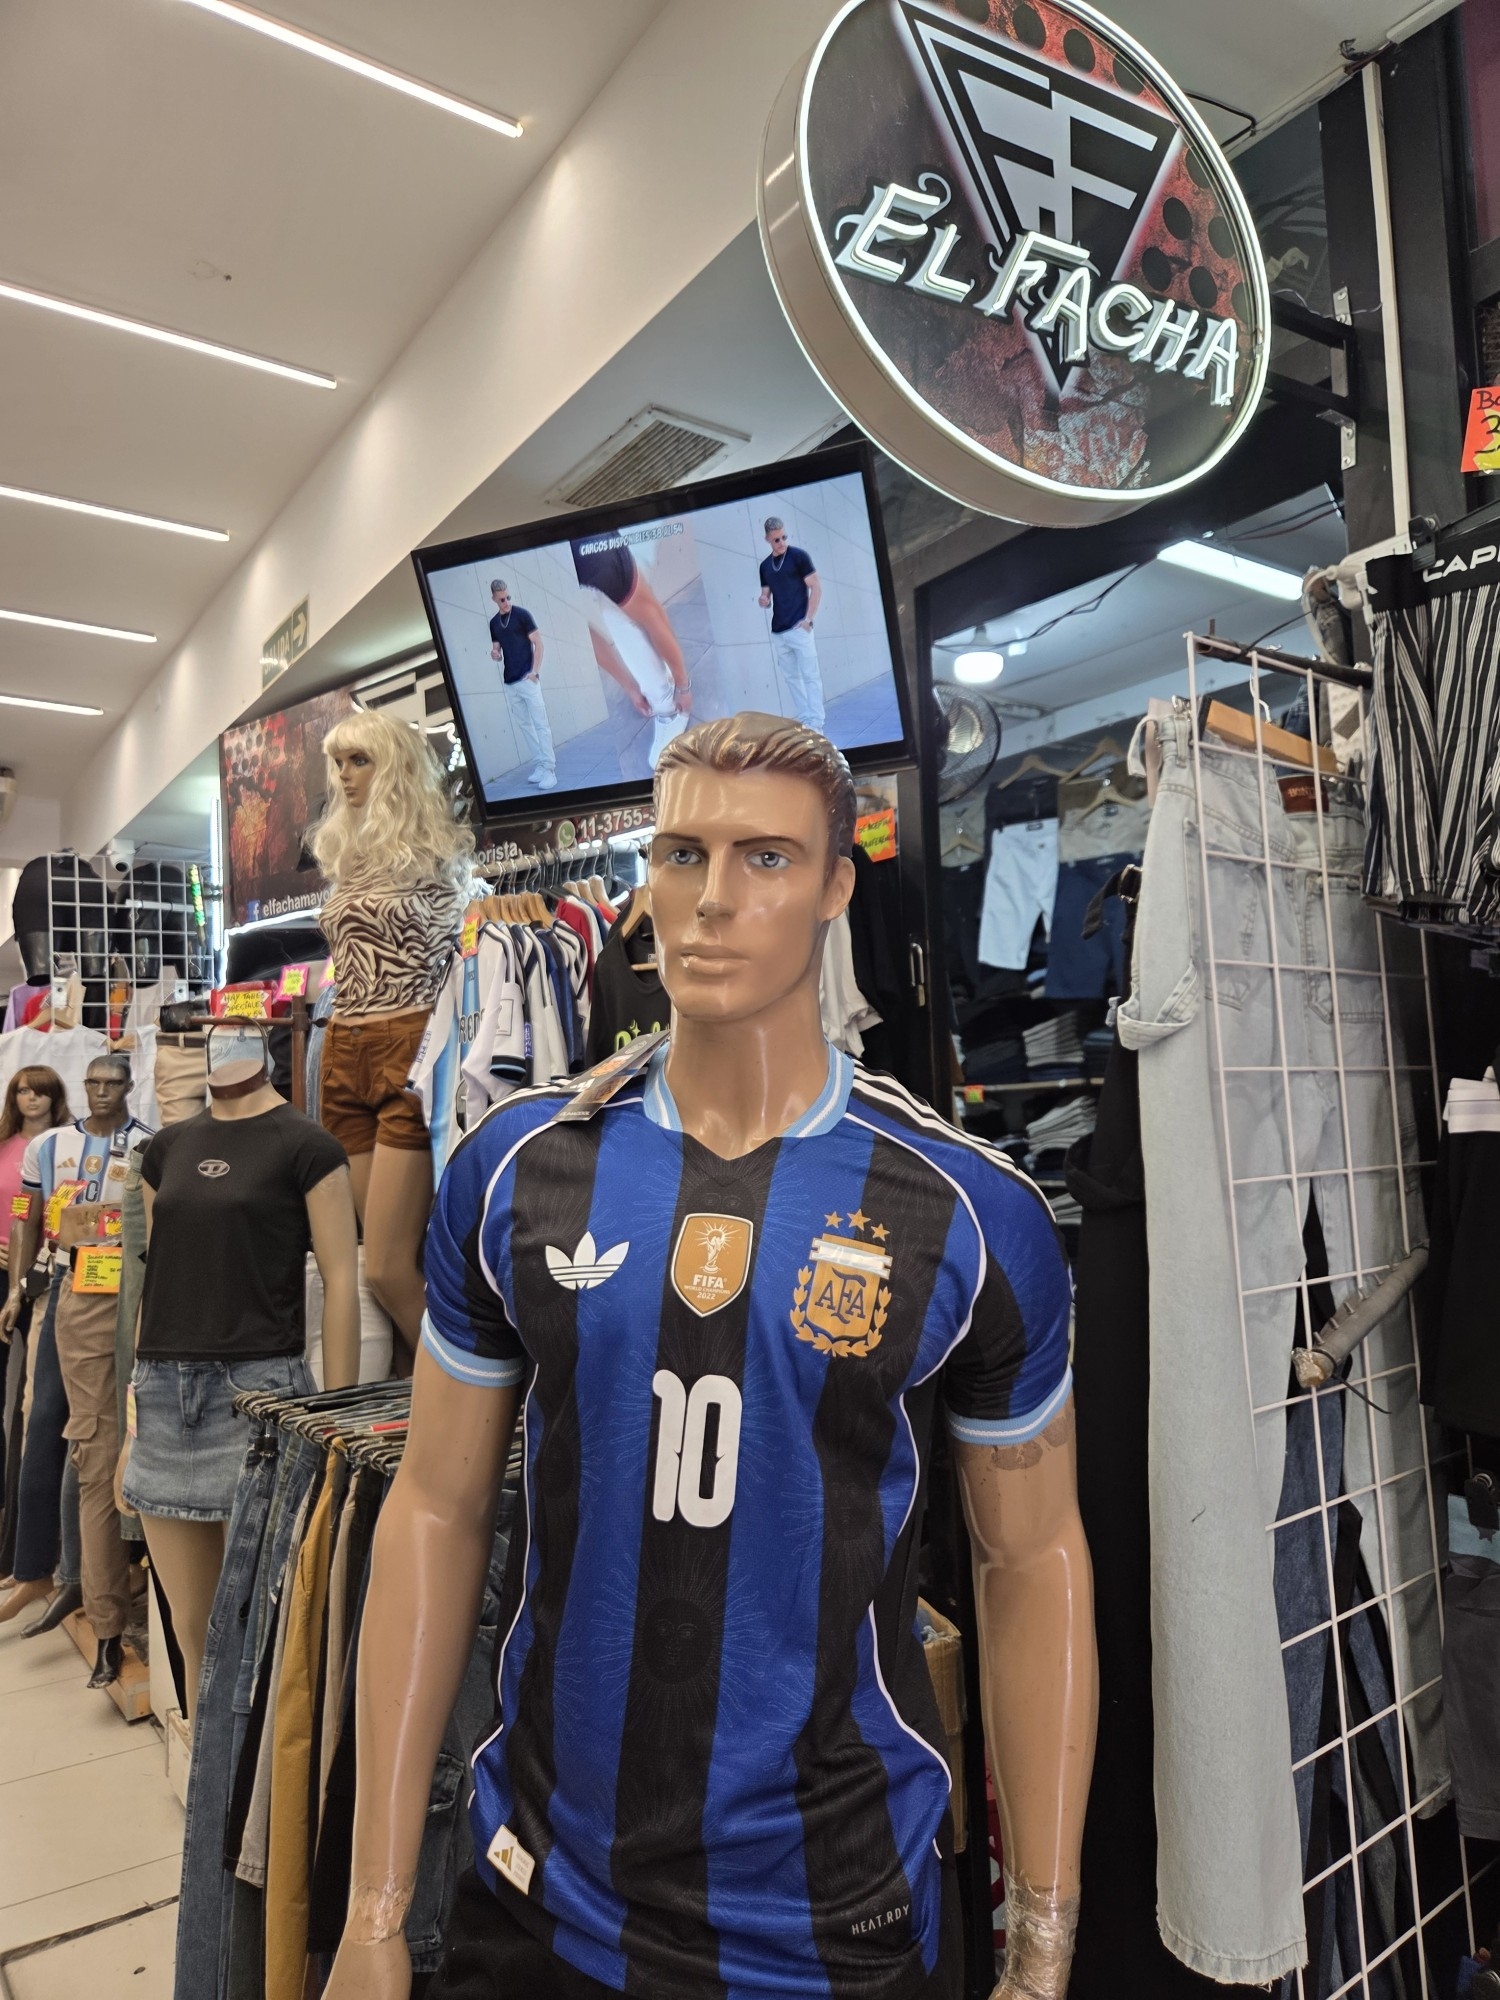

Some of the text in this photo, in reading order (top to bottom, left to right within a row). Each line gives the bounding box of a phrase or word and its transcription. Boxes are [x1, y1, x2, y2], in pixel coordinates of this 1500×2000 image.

[835, 173, 1240, 406] EL FACHA
[580, 540, 608, 556] CARGOS
[1423, 545, 1500, 583] CAP
[477, 841, 518, 865] orista
[262, 889, 330, 917] elfachamayo
[692, 1274, 724, 1289] FIFA
[696, 1291, 716, 1300] 2022
[814, 1267, 867, 1325] AFA
[652, 1369, 742, 1528] 10
